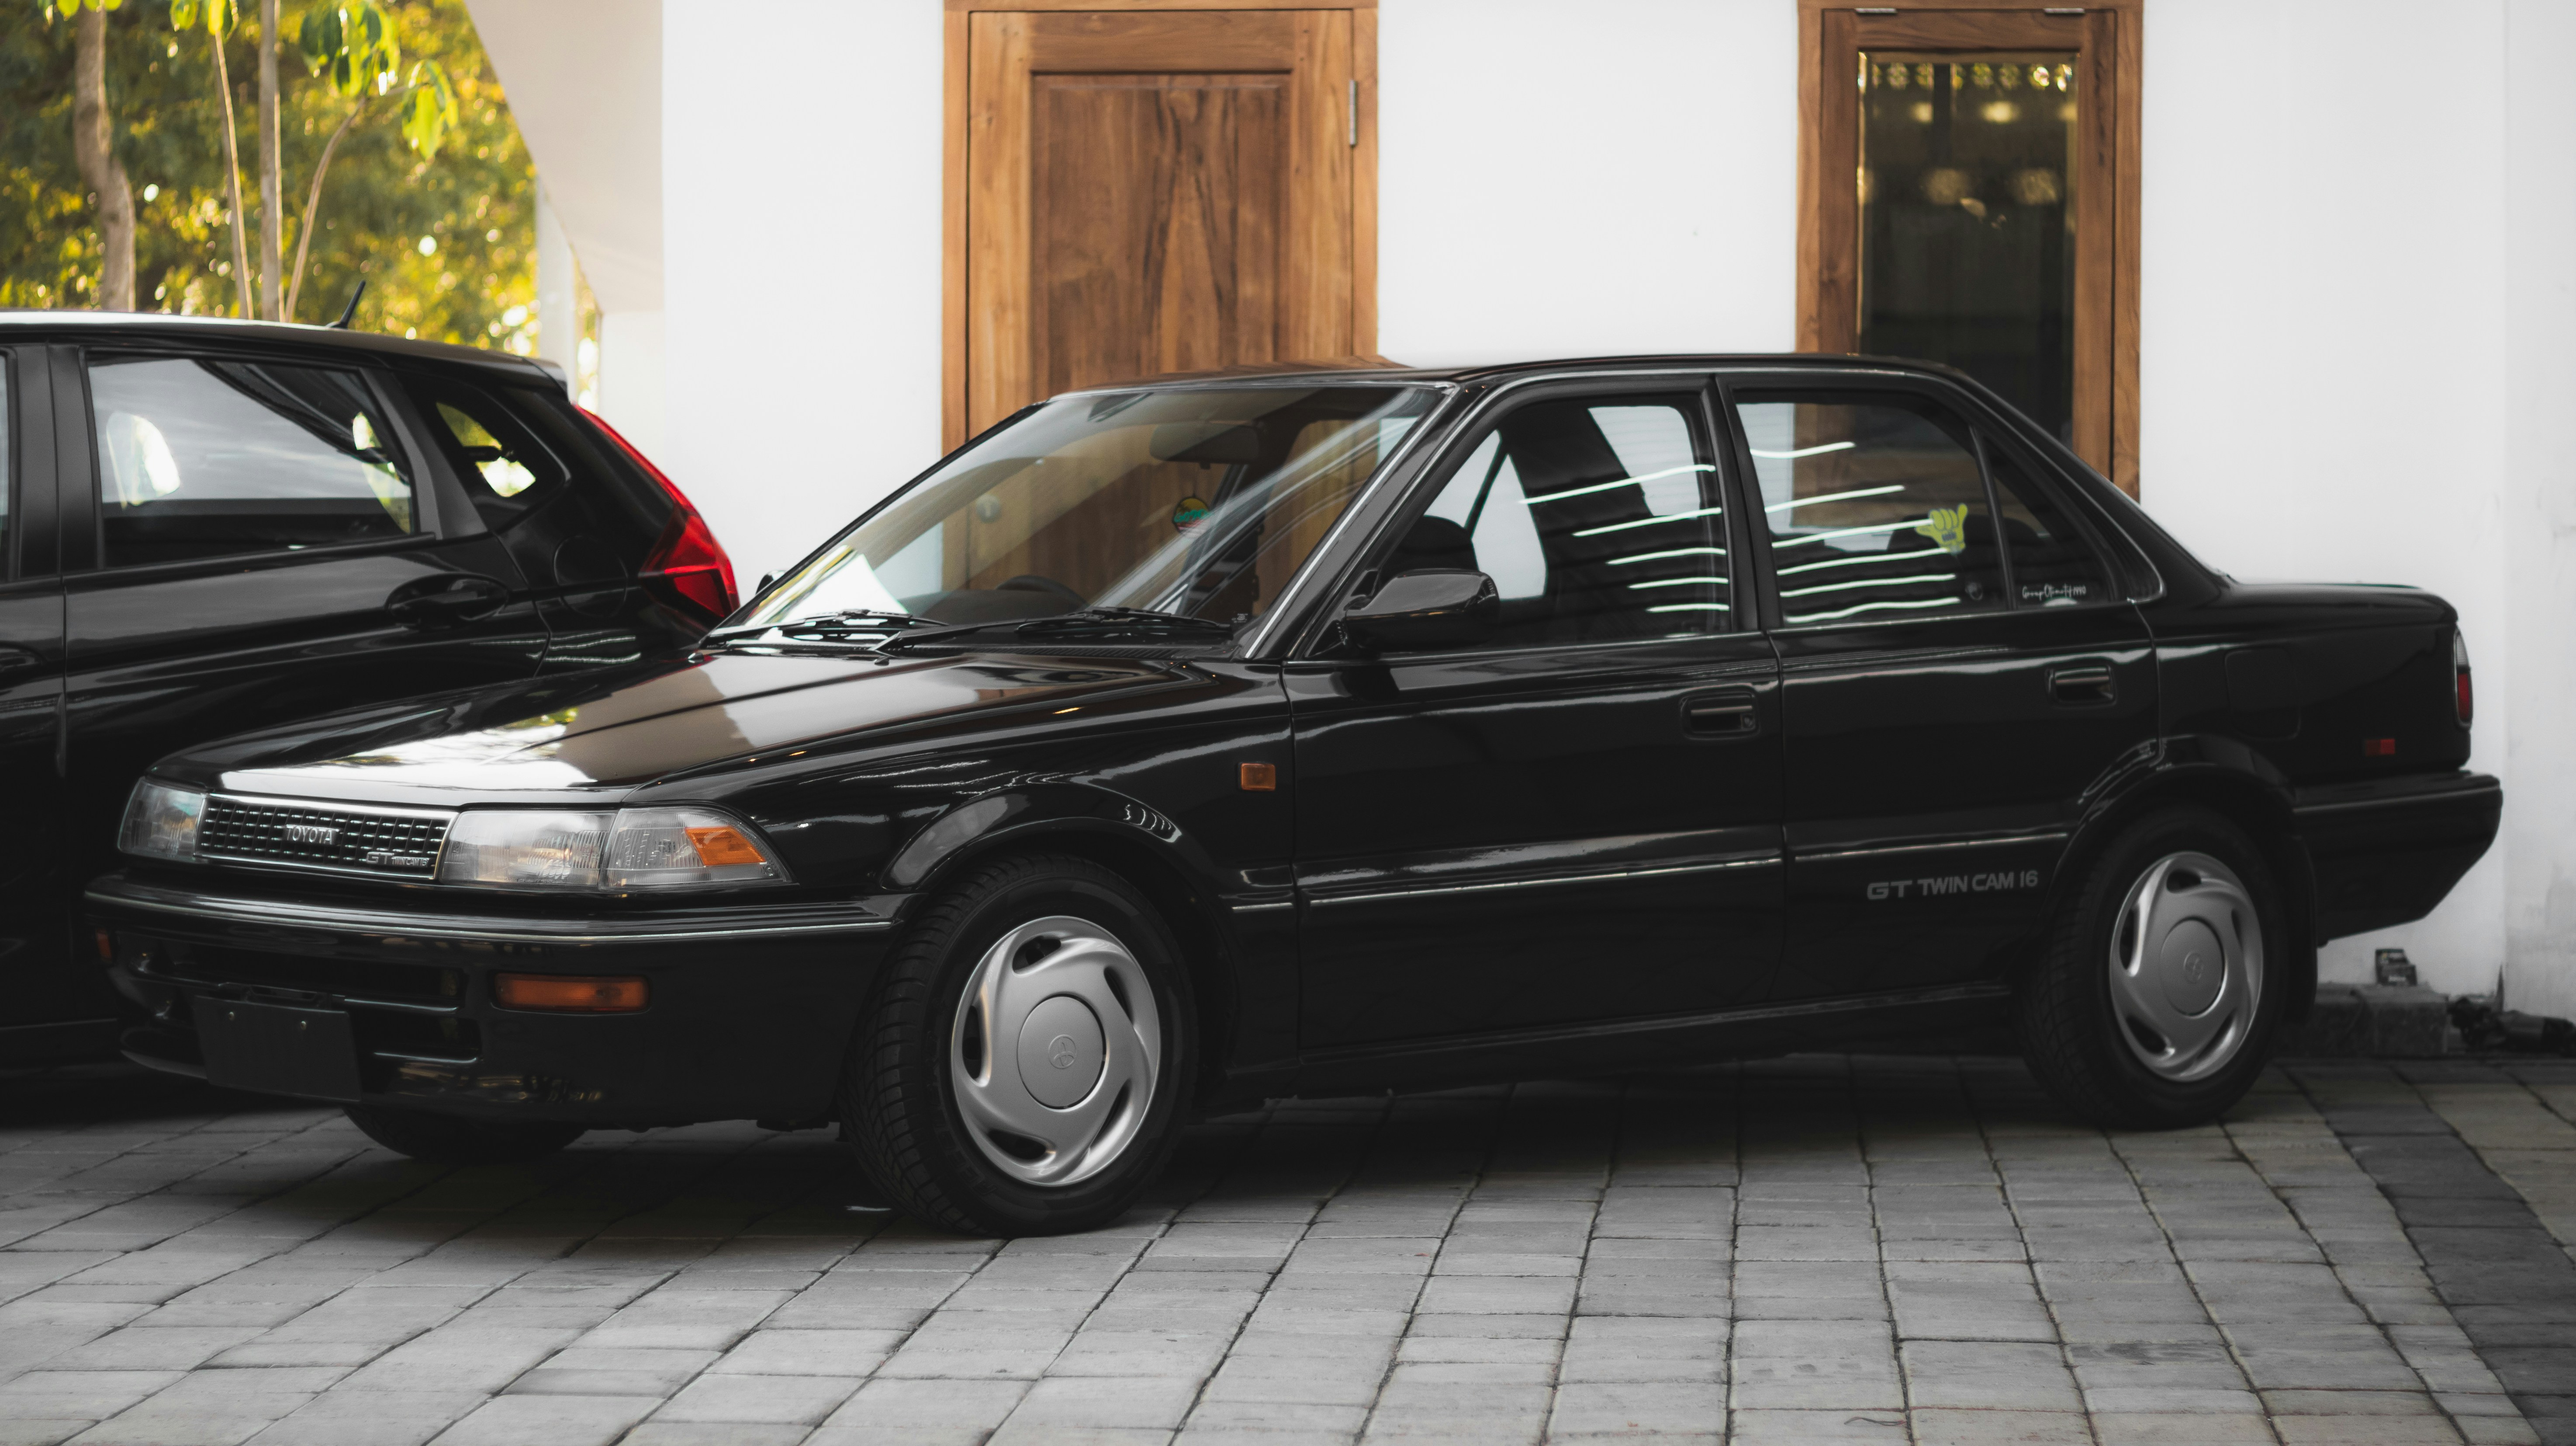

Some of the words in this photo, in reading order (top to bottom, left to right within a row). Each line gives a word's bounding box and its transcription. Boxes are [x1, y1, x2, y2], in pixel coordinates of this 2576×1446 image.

[286, 824, 335, 845] TOYOTA
[366, 851, 394, 865] GT
[1867, 880, 1912, 900] GT
[1917, 875, 1967, 896] TWIN
[1972, 872, 2014, 891] CAM
[2019, 870, 2039, 889] 16
